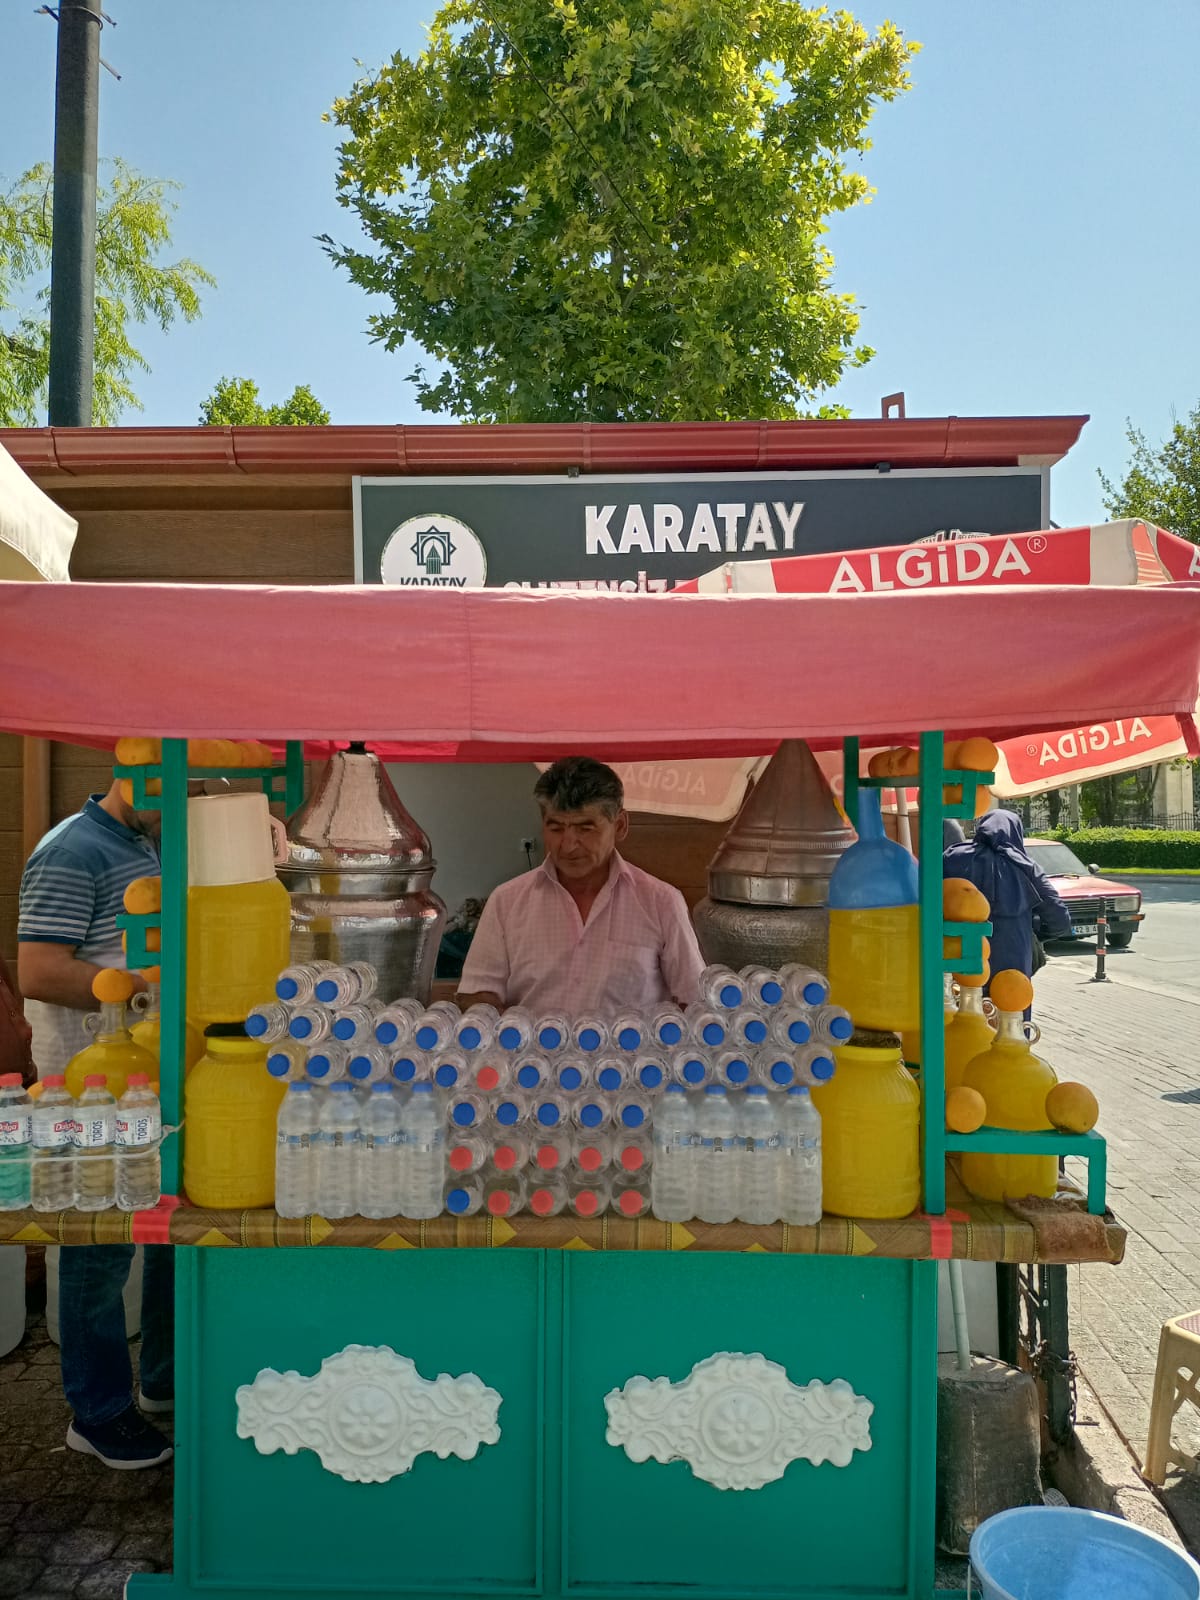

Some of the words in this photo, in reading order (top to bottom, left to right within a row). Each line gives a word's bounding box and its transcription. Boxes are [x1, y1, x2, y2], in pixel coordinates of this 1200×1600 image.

[584, 502, 804, 554] KARATAY
[92, 1120, 103, 1142] TOROS
[137, 1118, 148, 1140] TOROS
